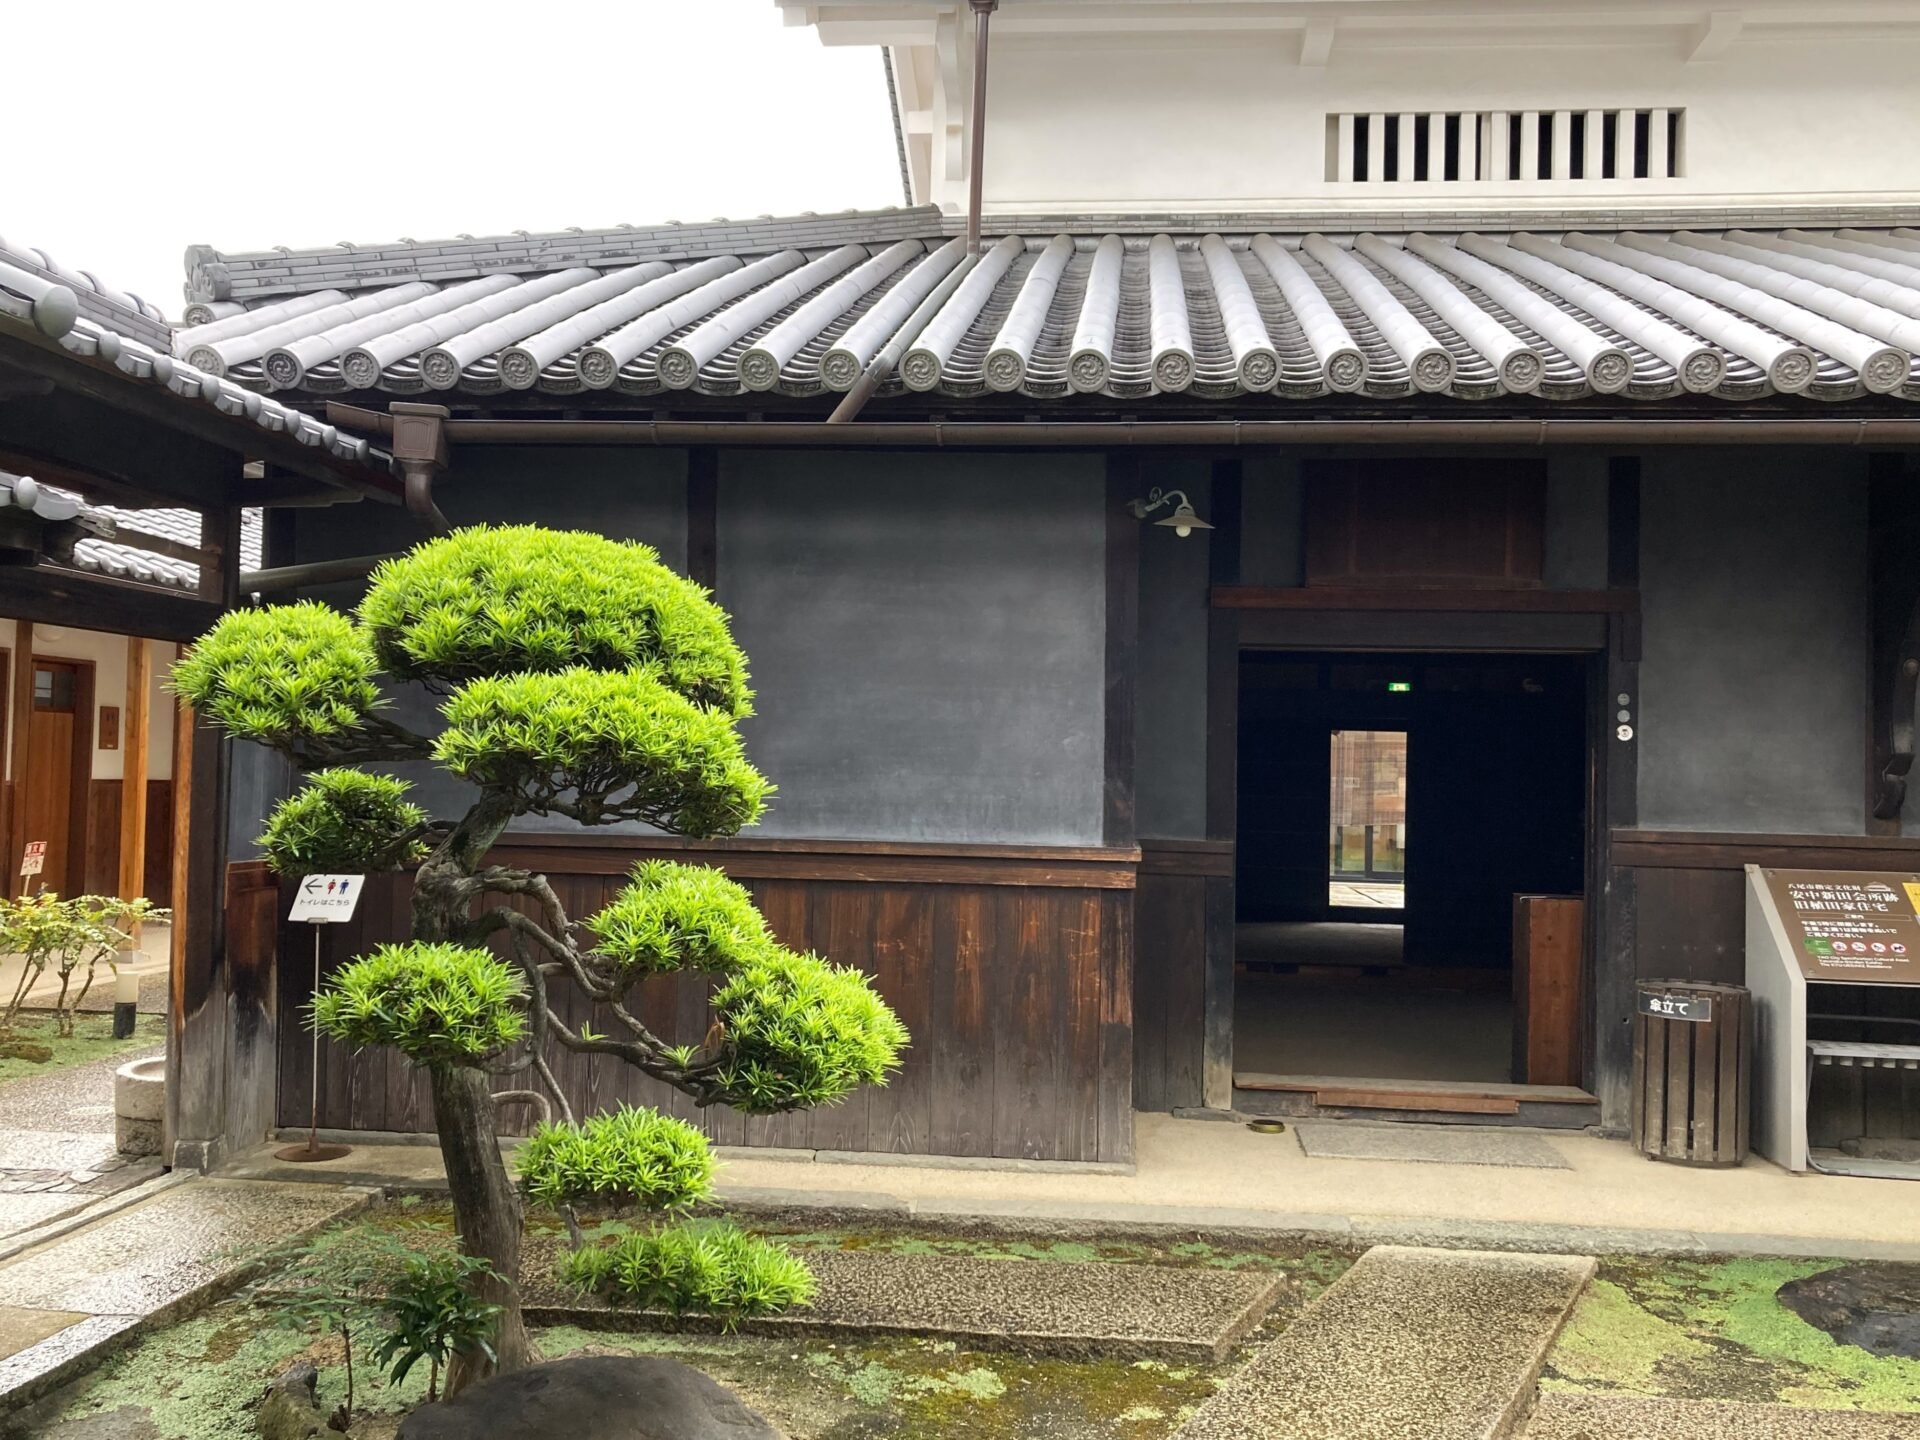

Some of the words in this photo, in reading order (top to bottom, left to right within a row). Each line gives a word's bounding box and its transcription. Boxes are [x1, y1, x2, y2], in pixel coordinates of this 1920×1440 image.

[1789, 890, 1899, 902] 安中新田会所跡
[1793, 901, 1889, 912] 旧植田家住宅
[1650, 998, 1689, 1015] 傘立て
